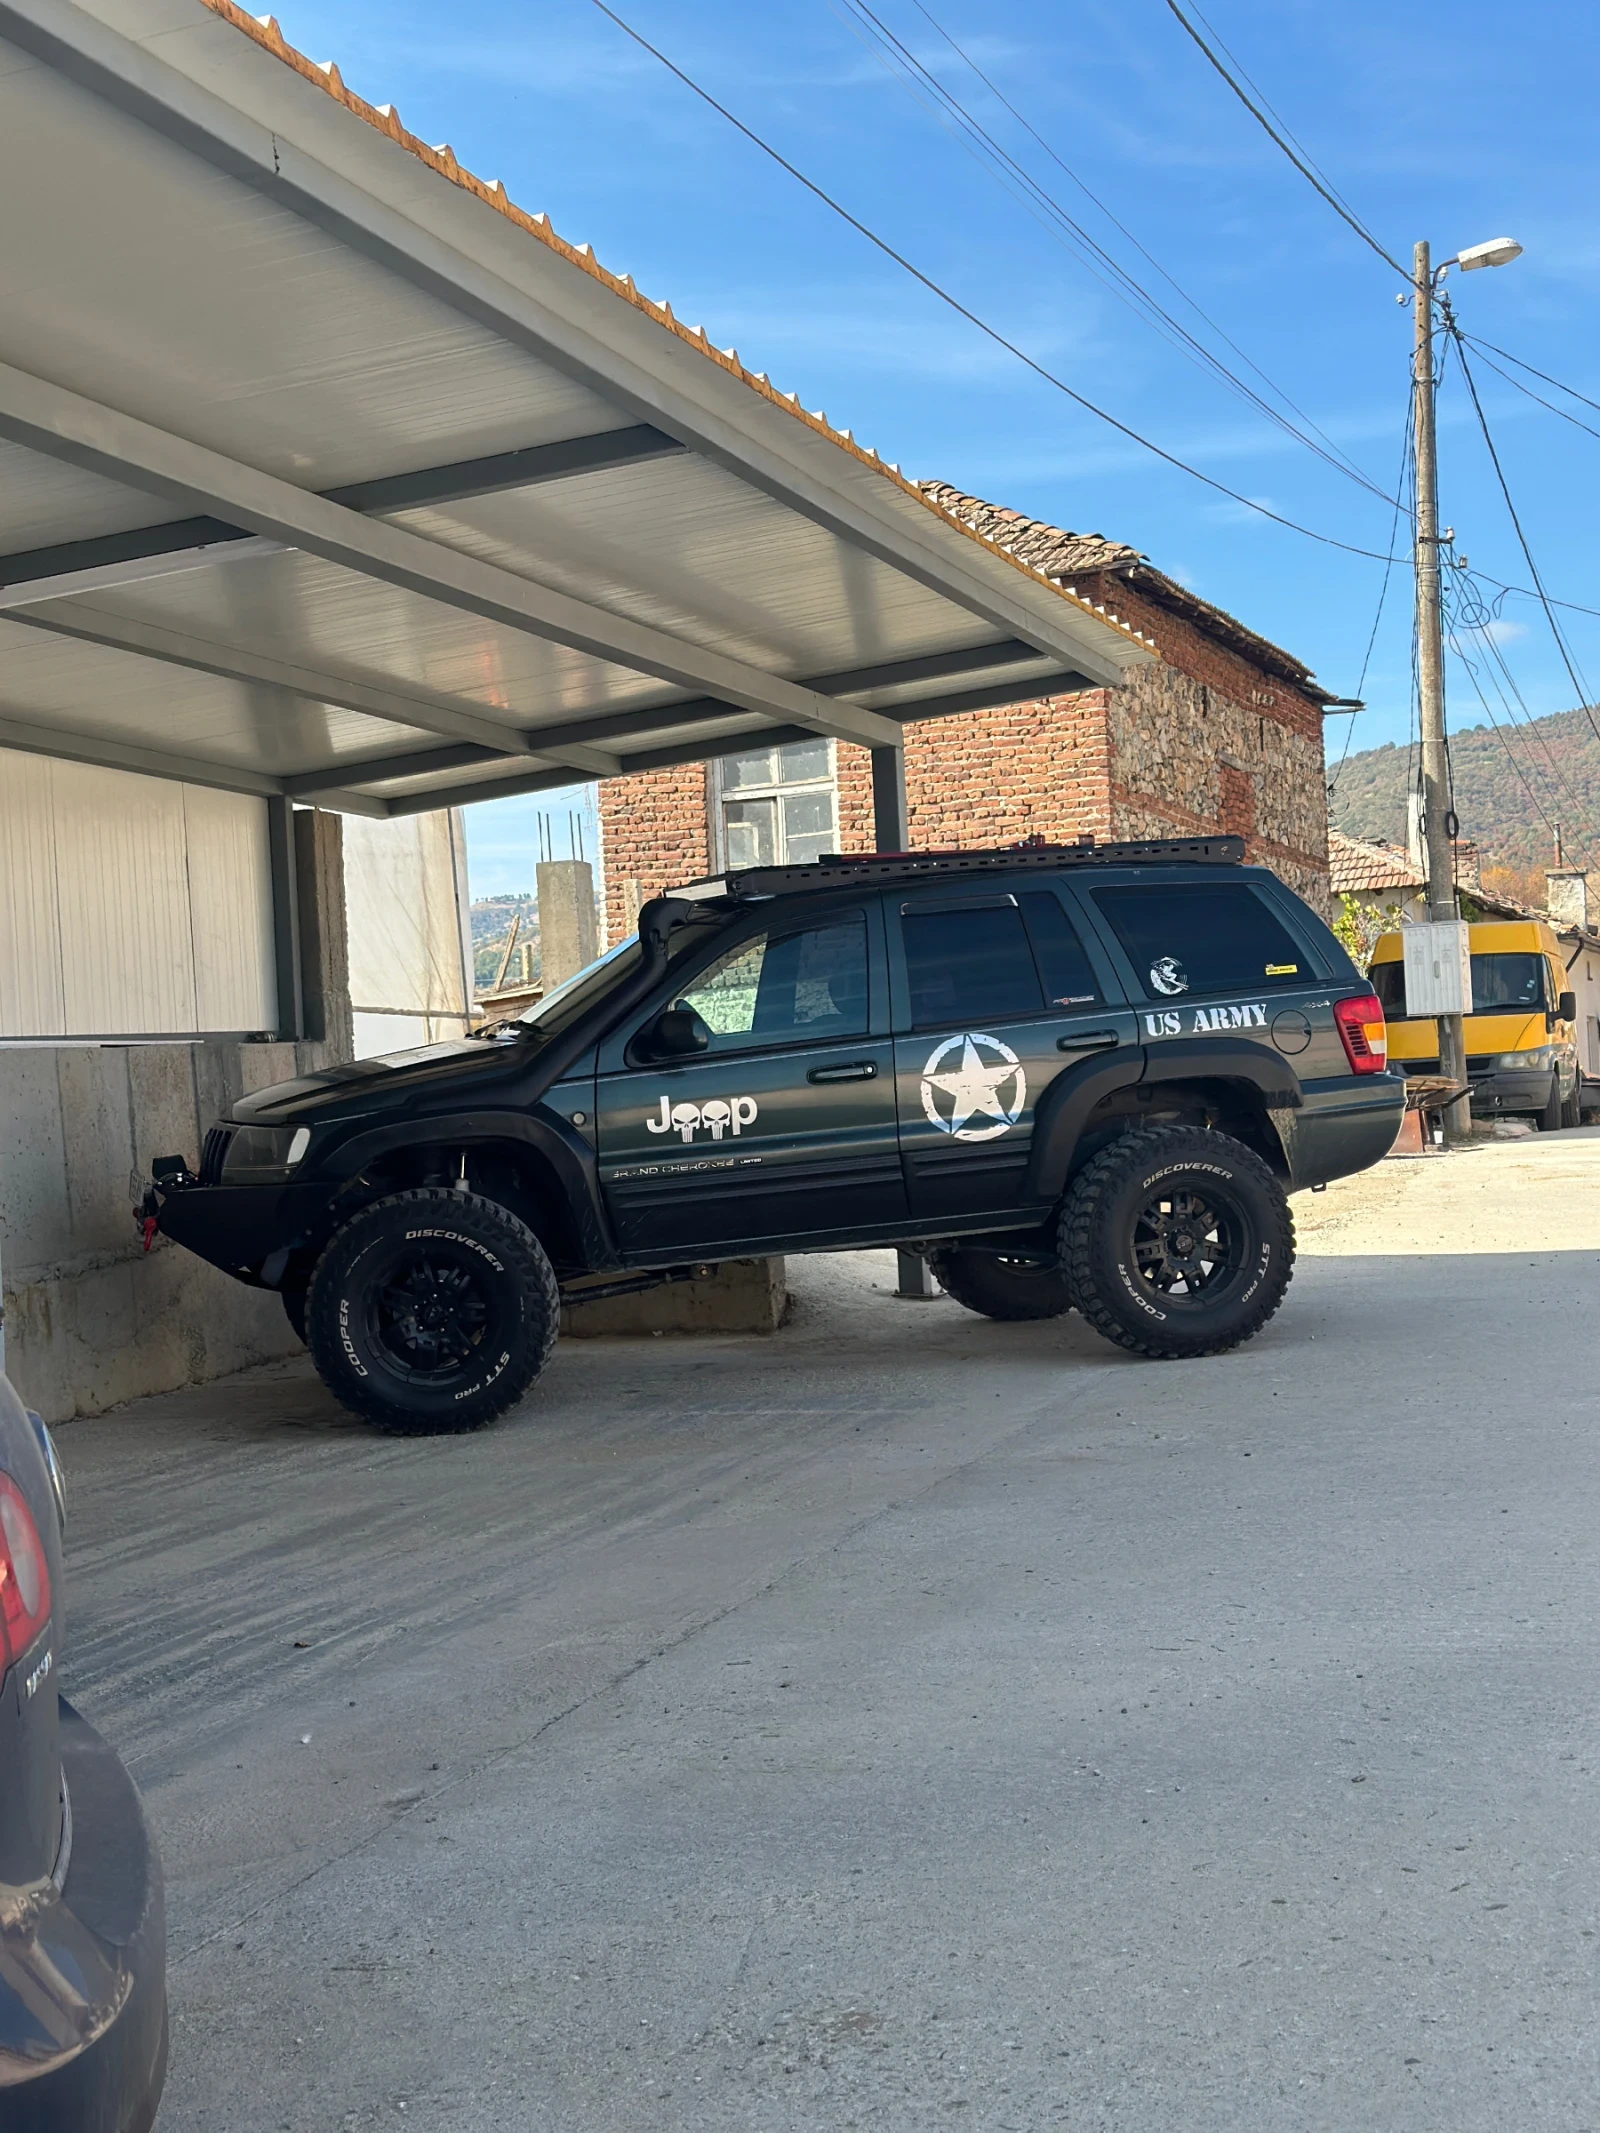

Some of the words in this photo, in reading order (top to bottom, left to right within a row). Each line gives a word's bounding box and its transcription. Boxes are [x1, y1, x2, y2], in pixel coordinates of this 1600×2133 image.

[1144, 1011, 1182, 1037] US
[1192, 1003, 1268, 1033] ARMY
[1142, 1162, 1233, 1189] DISCOVERER
[405, 1229, 505, 1272] DISCOVERER
[1256, 1242, 1271, 1279] STT
[1117, 1262, 1168, 1321] COOPER
[1241, 1279, 1259, 1303] PRO
[336, 1298, 369, 1378] COOPER
[485, 1350, 511, 1387] STT
[454, 1382, 481, 1401] PRO
